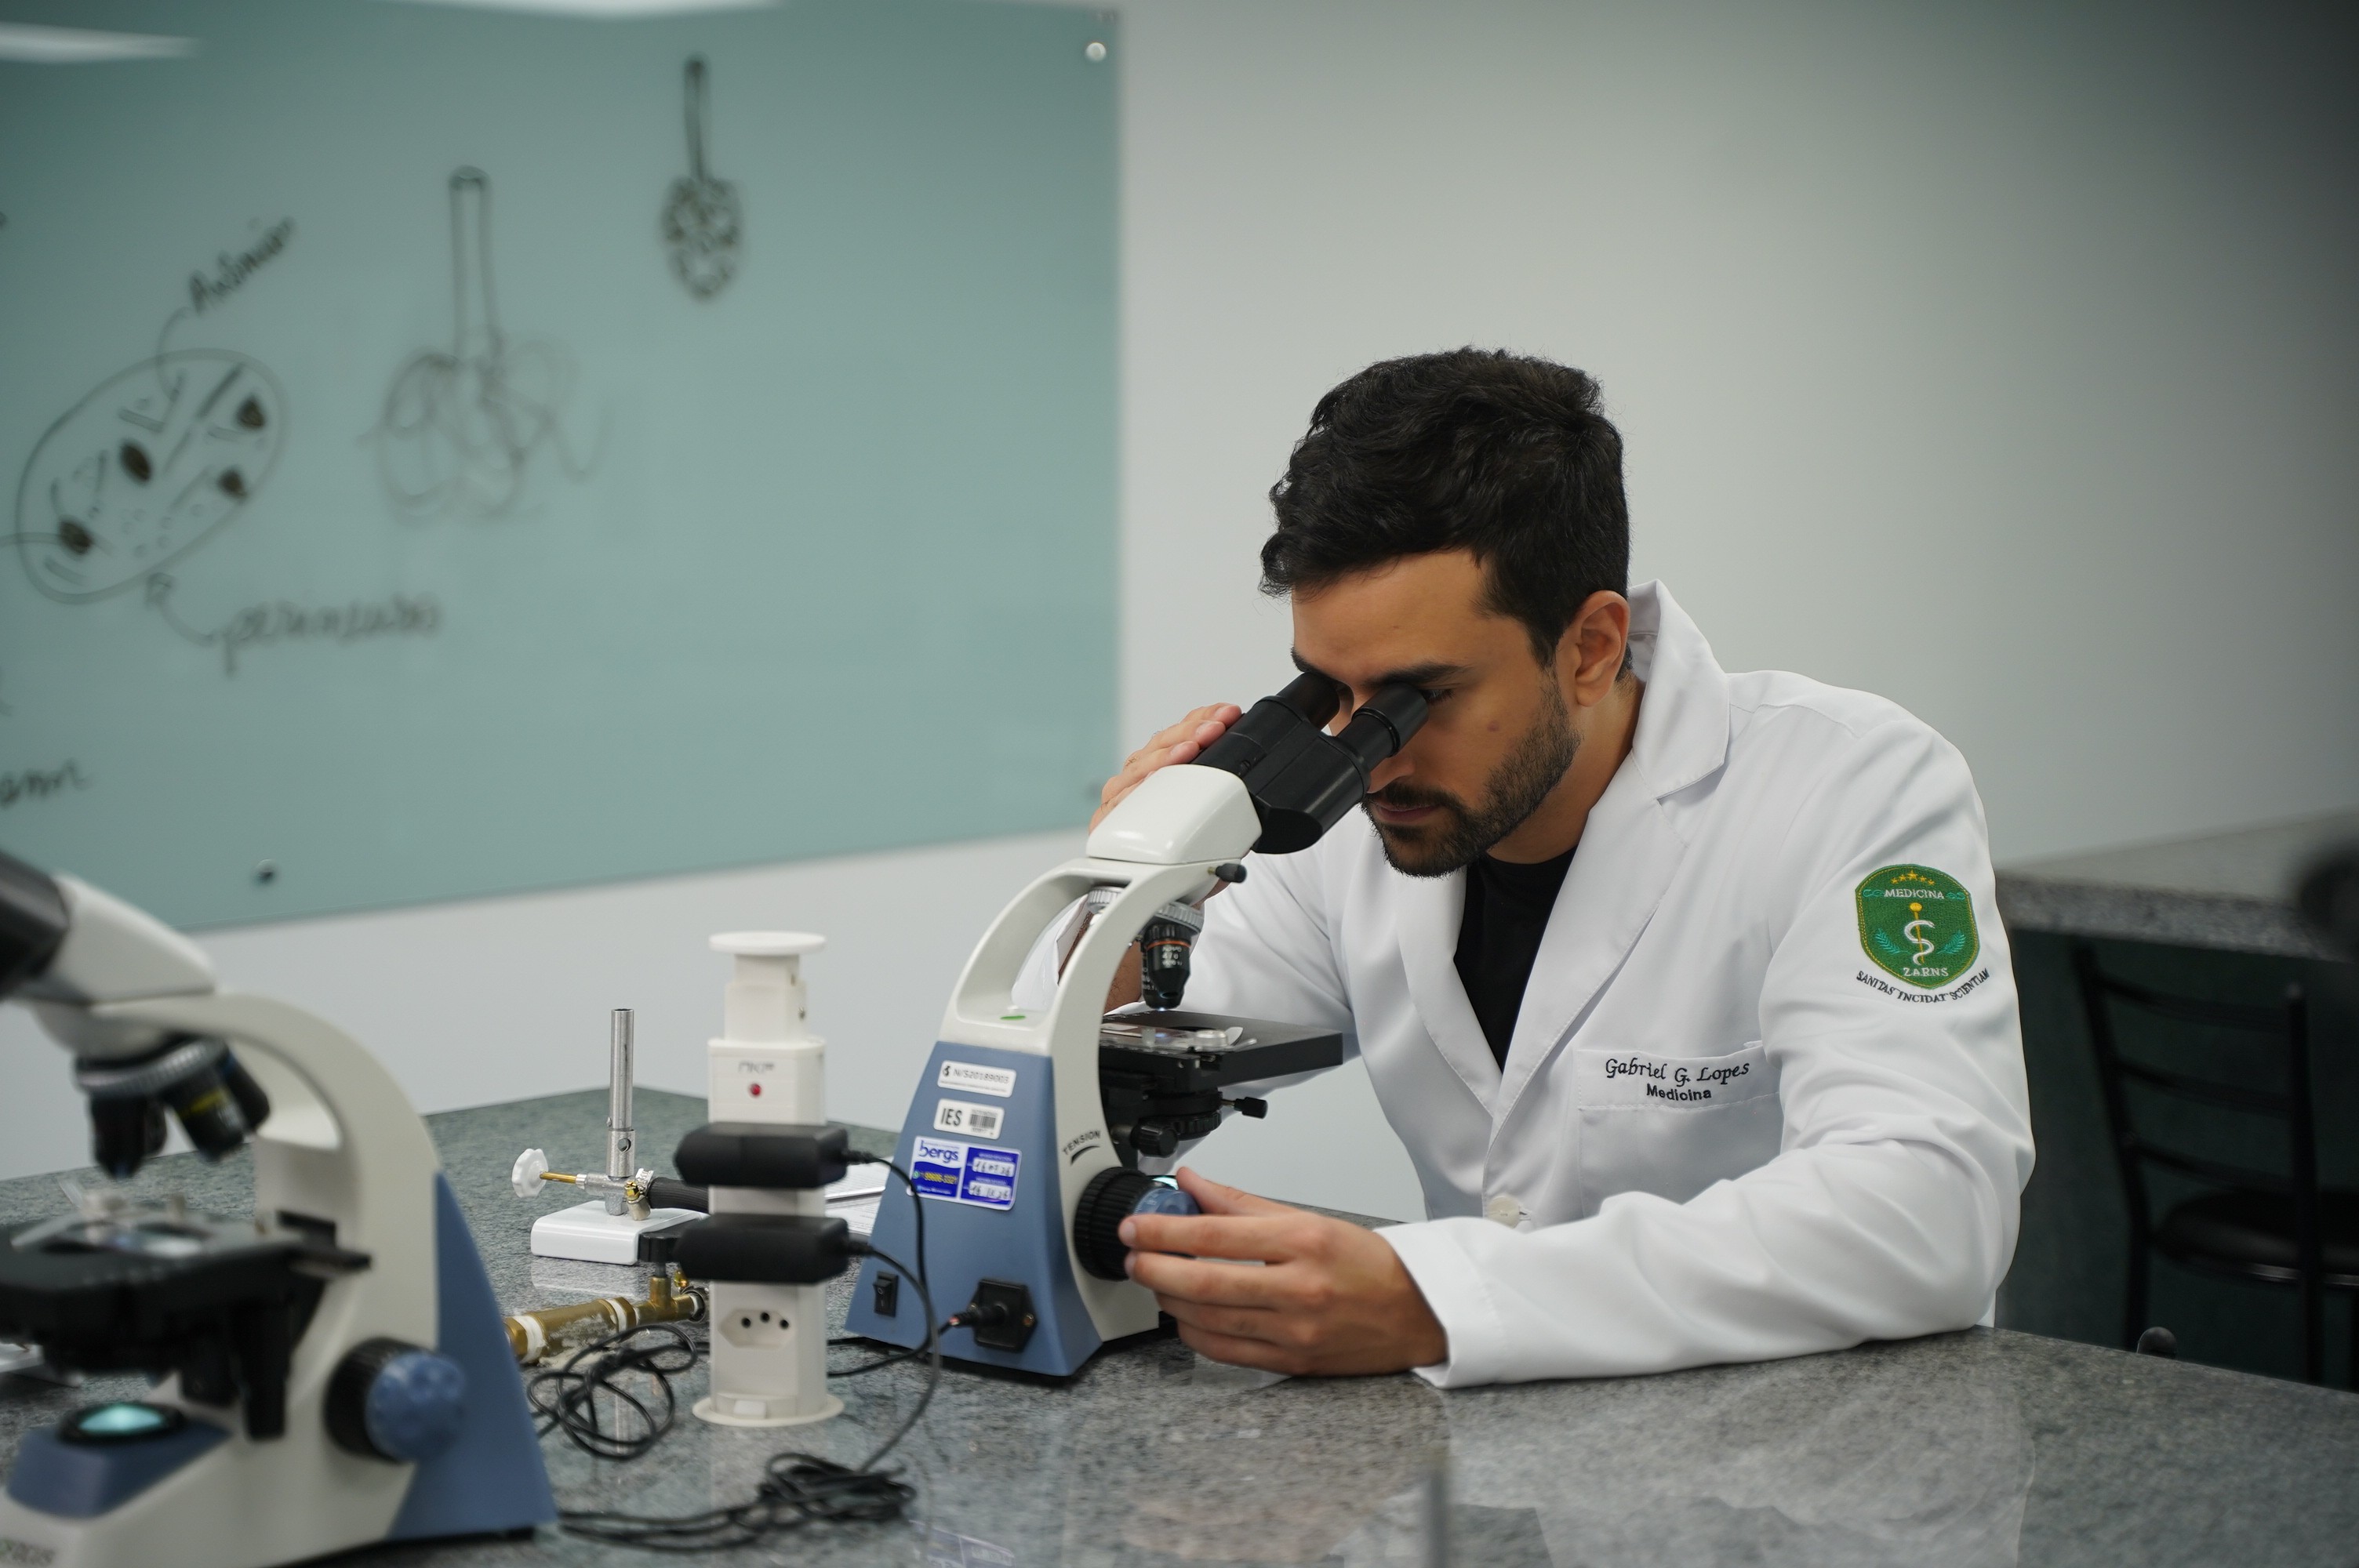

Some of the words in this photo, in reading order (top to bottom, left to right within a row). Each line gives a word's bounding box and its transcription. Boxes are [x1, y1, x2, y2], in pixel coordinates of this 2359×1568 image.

[1884, 889, 1945, 900] MEDICINA
[1903, 967, 1949, 977] ZARNS
[1856, 971, 1896, 996] SANITAS
[1896, 990, 1946, 1004] INCIDAT
[1949, 967, 1990, 1000] SCIENTIAM
[1605, 1057, 1668, 1080] Gabriel
[1674, 1067, 1691, 1087] G.
[1696, 1062, 1750, 1085] Lopes
[1646, 1083, 1712, 1102] Medicina
[940, 1107, 962, 1127] IES
[918, 1140, 959, 1163] bergs
[1062, 1129, 1102, 1155] TENSION
